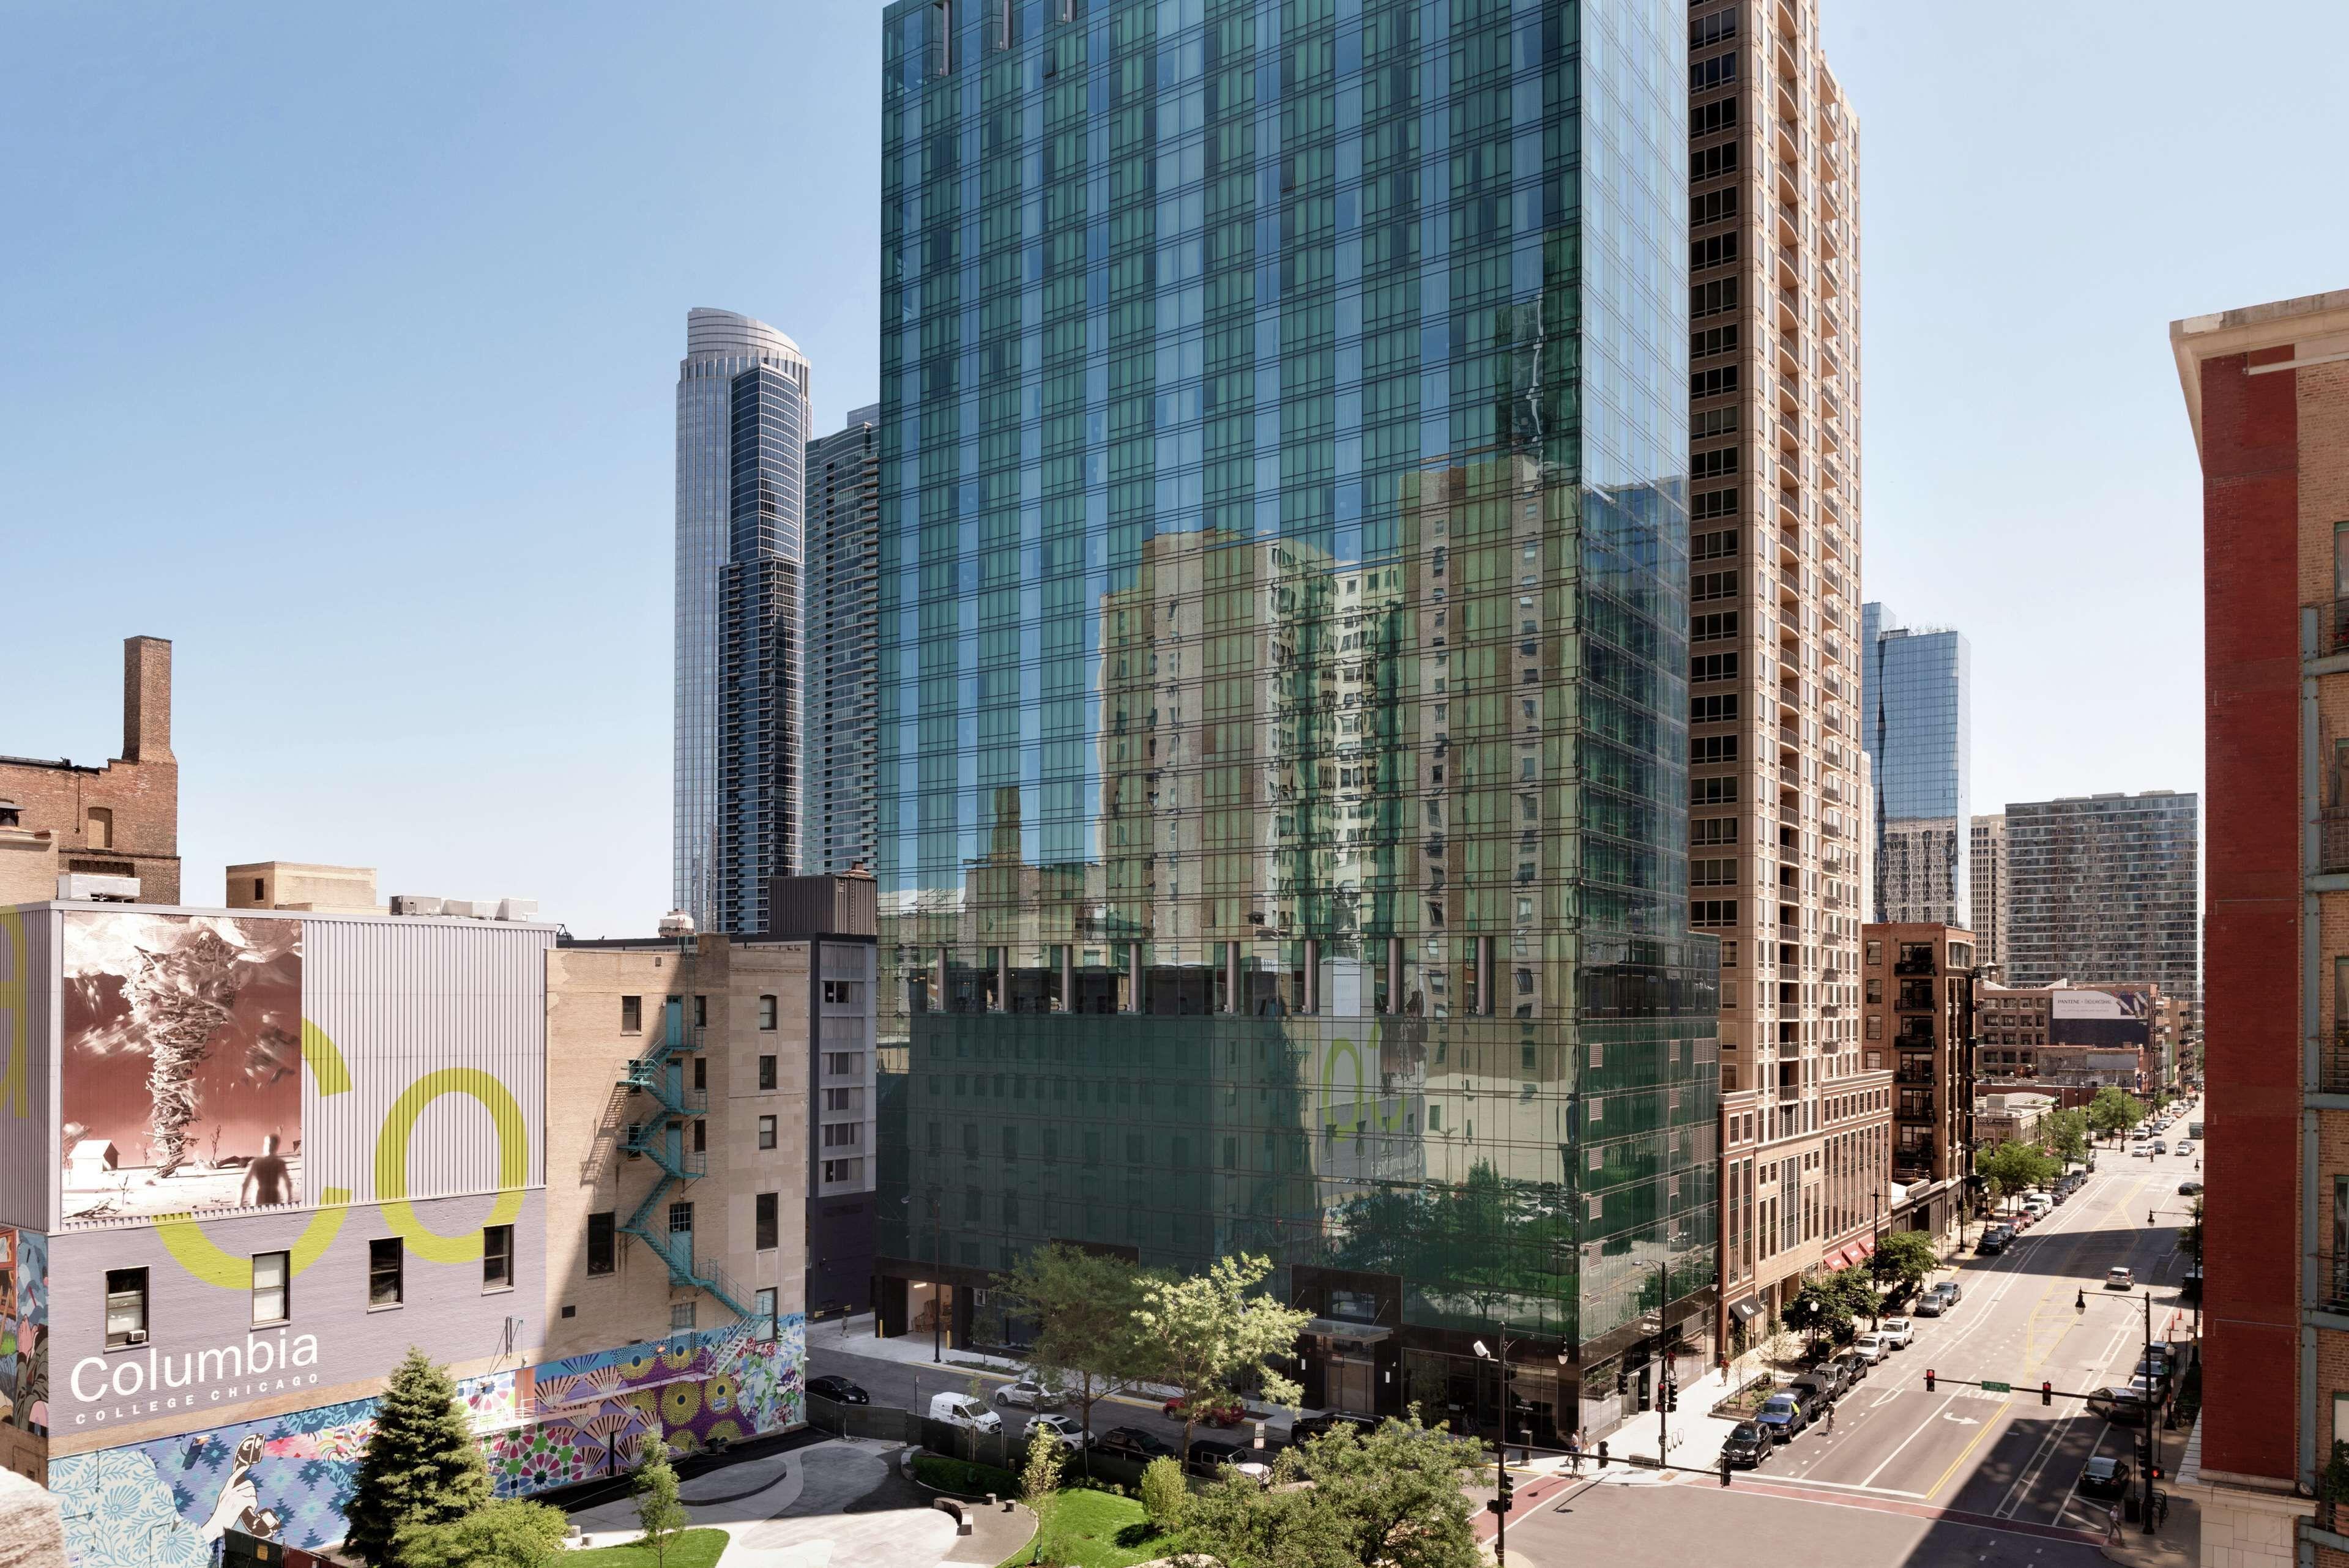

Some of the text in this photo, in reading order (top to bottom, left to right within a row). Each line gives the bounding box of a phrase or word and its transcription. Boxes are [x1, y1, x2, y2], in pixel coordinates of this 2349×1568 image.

[71, 1328, 318, 1402] Columbia
[75, 1373, 318, 1425] COLLEGE CHICAGO
